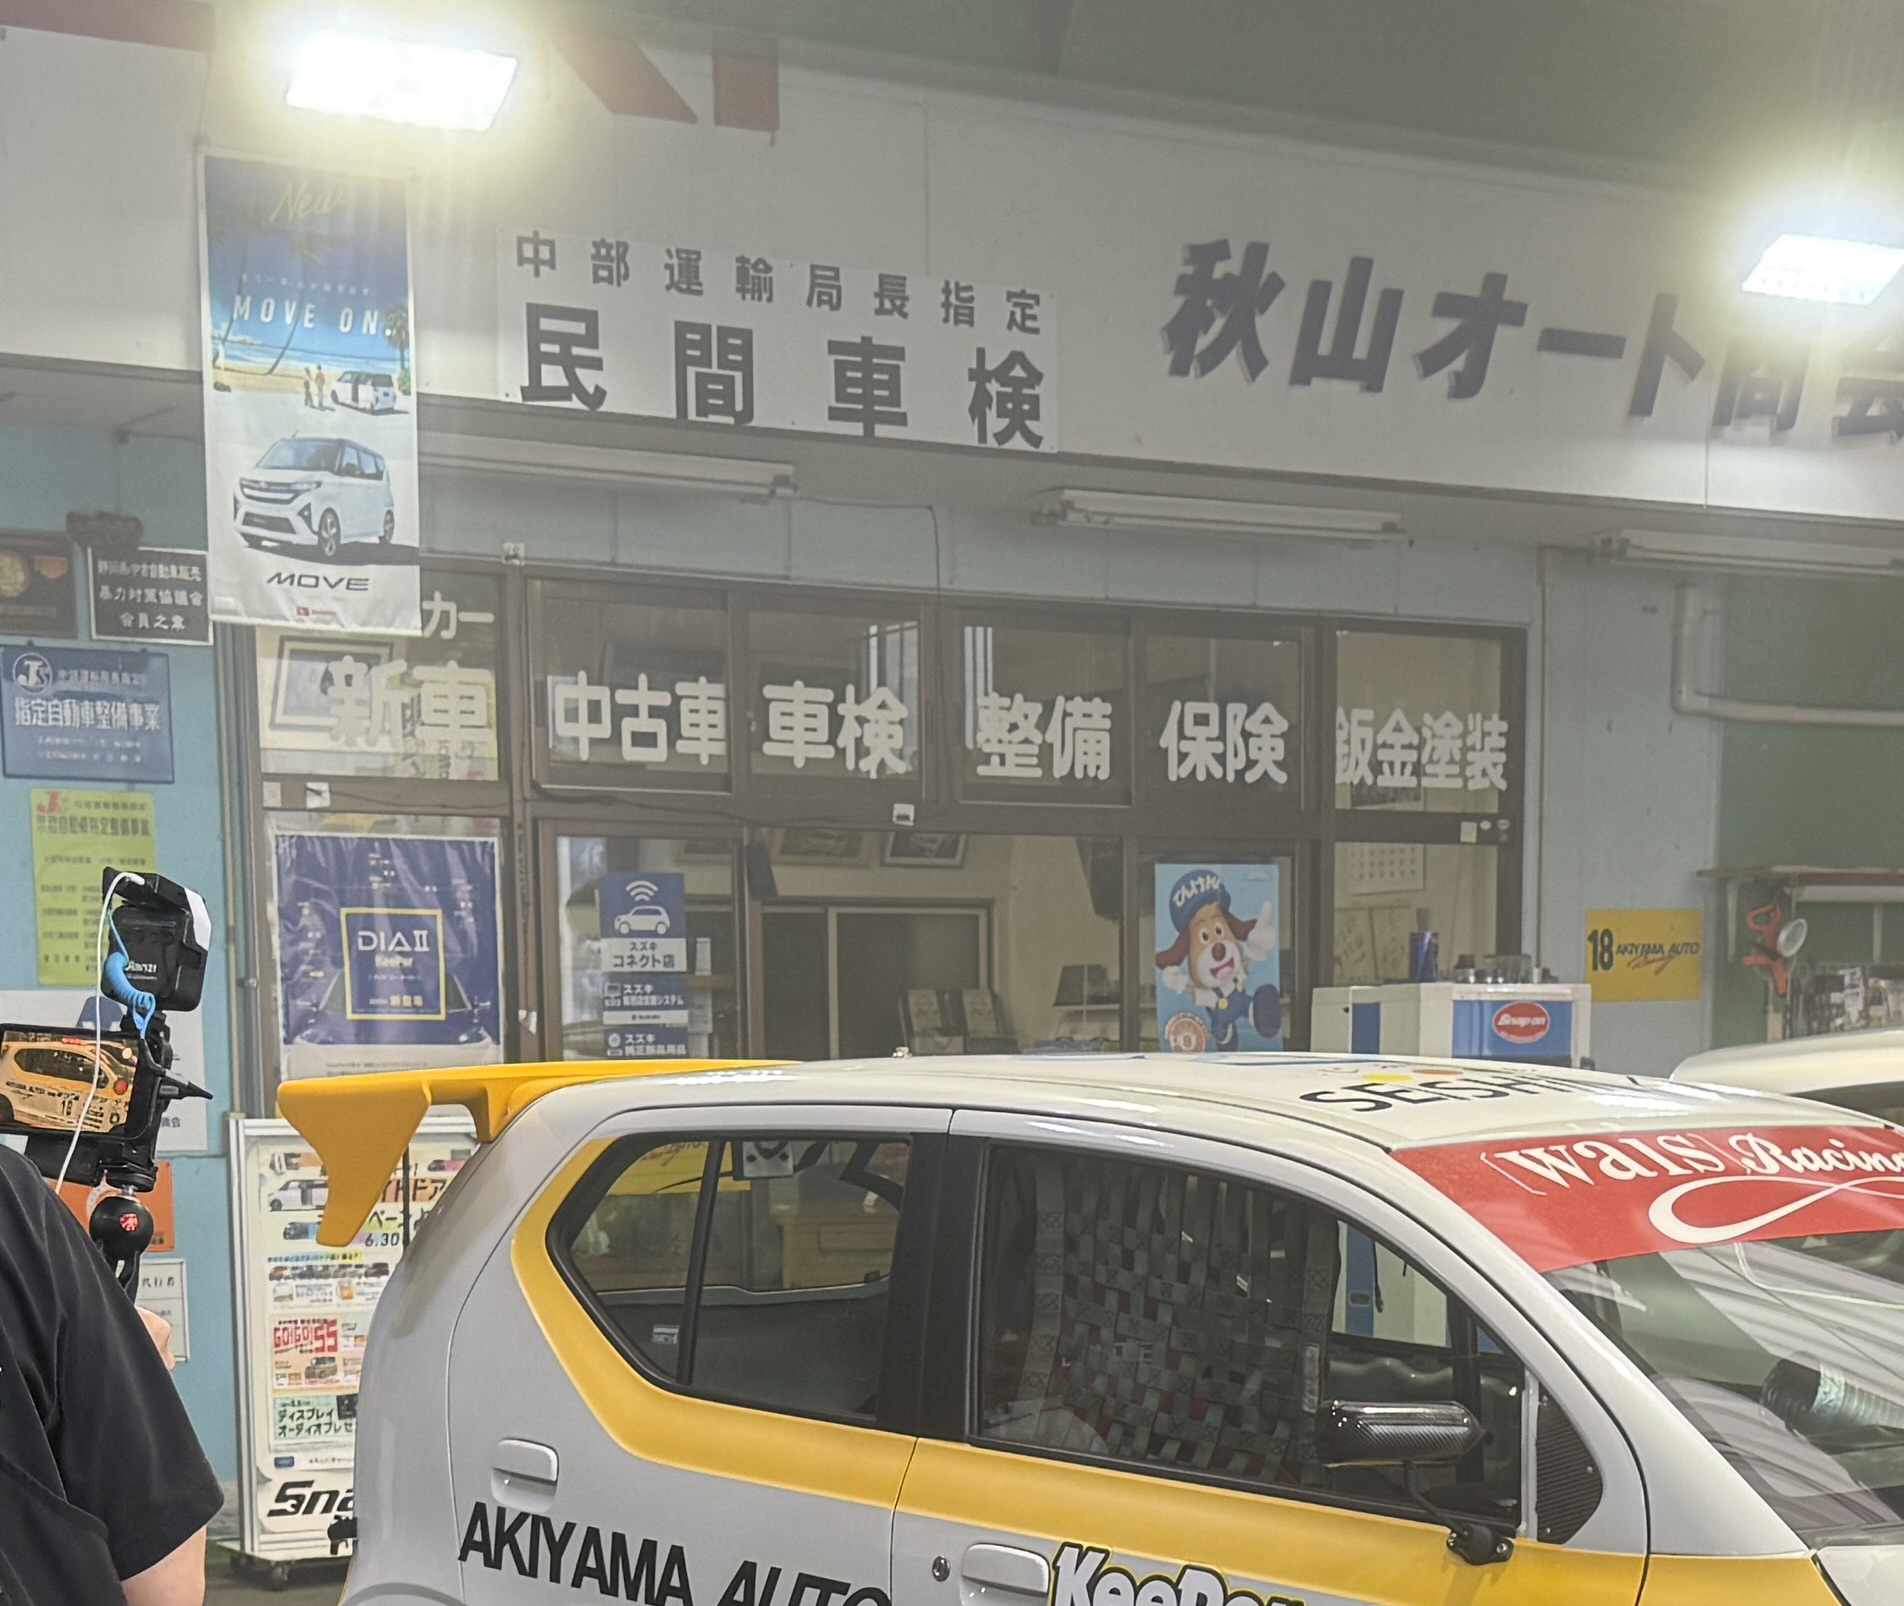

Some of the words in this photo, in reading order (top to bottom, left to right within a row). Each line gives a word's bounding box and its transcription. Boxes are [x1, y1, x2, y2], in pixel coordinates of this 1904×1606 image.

[233, 296, 316, 329] MOVE
[515, 230, 1042, 335] 中部運輸局長指定
[519, 302, 1044, 448] 民間車検
[267, 572, 370, 592] MOVE
[14, 697, 161, 731] 指定自動車整備事業
[327, 656, 492, 747] 新車
[555, 670, 727, 763] 中古車
[764, 680, 910, 778] 車検
[976, 692, 1112, 781] 整備
[1159, 700, 1290, 786] 保険
[1334, 707, 1509, 792] 鈑金塗装
[1587, 928, 1614, 972] 18
